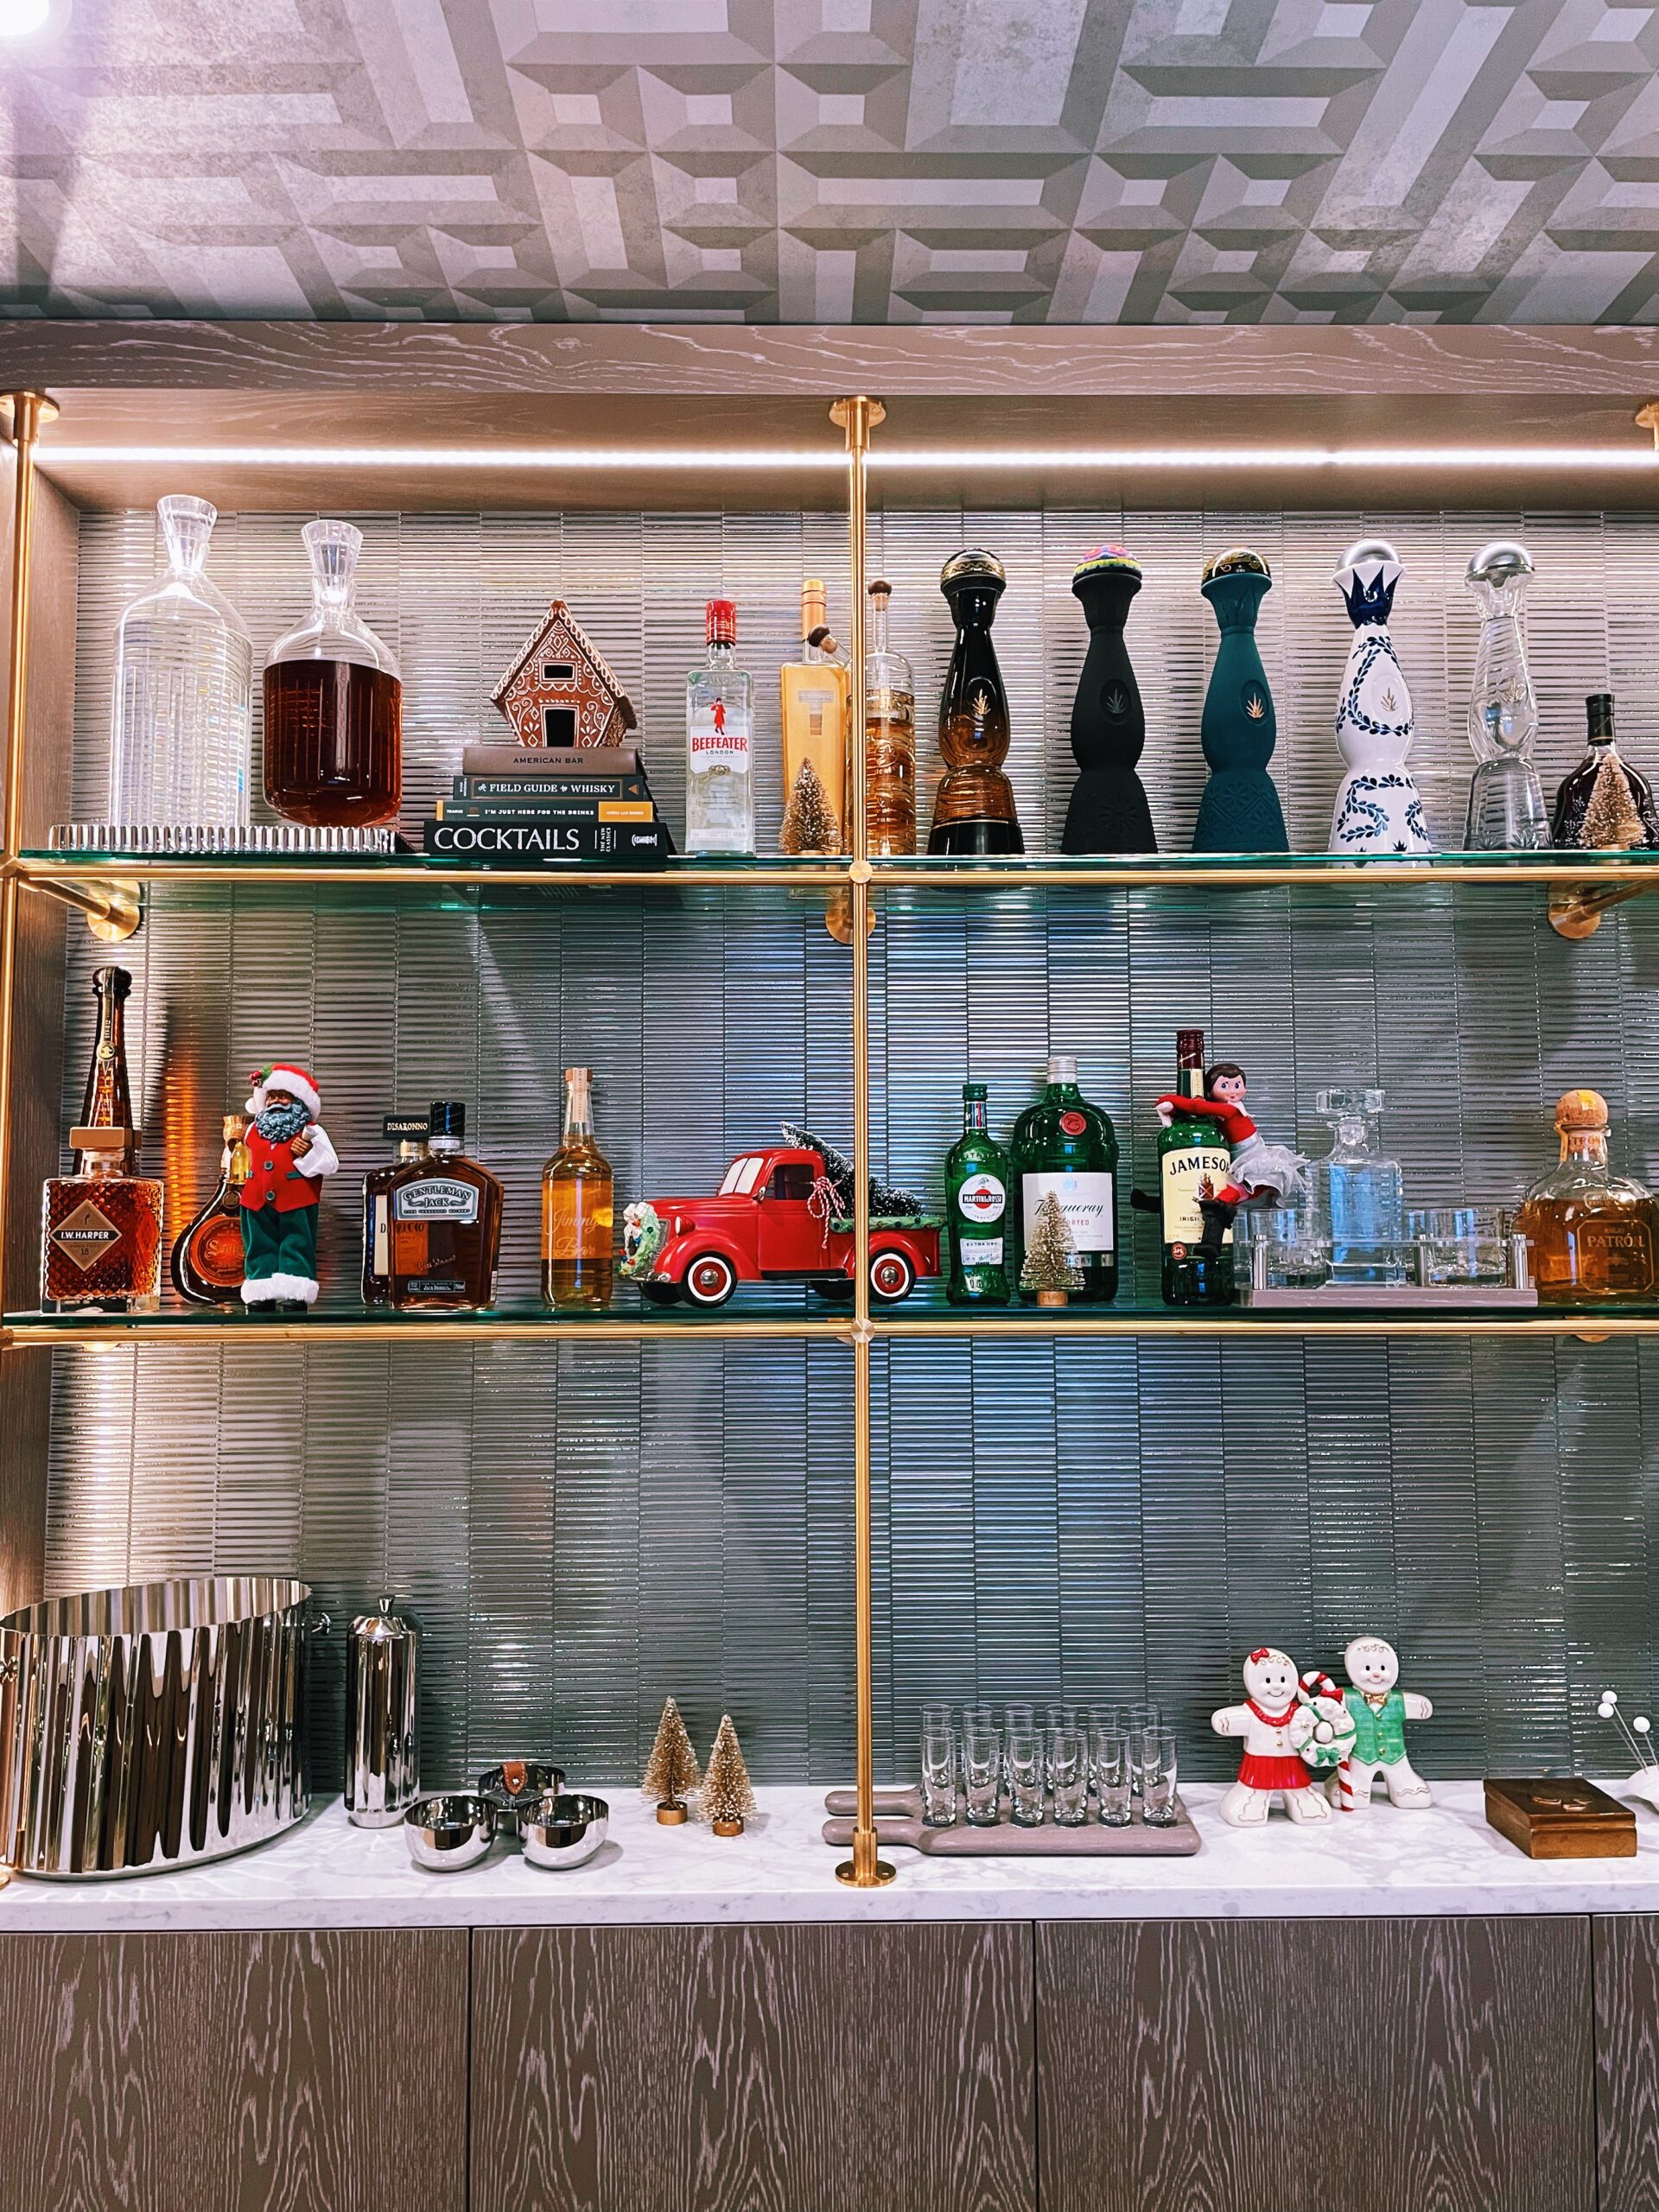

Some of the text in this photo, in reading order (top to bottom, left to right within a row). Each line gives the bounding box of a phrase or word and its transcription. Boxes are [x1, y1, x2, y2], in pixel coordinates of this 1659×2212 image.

[692, 737, 747, 752] BEEFEATER
[478, 783, 487, 792] A
[489, 784, 521, 792] FIELD
[524, 784, 558, 792] GUIDE
[434, 827, 580, 850] COCKTAILS
[387, 1122, 429, 1131] DISARONNO
[403, 1185, 472, 1201] GENTLEMAN
[424, 1198, 449, 1208] JACK
